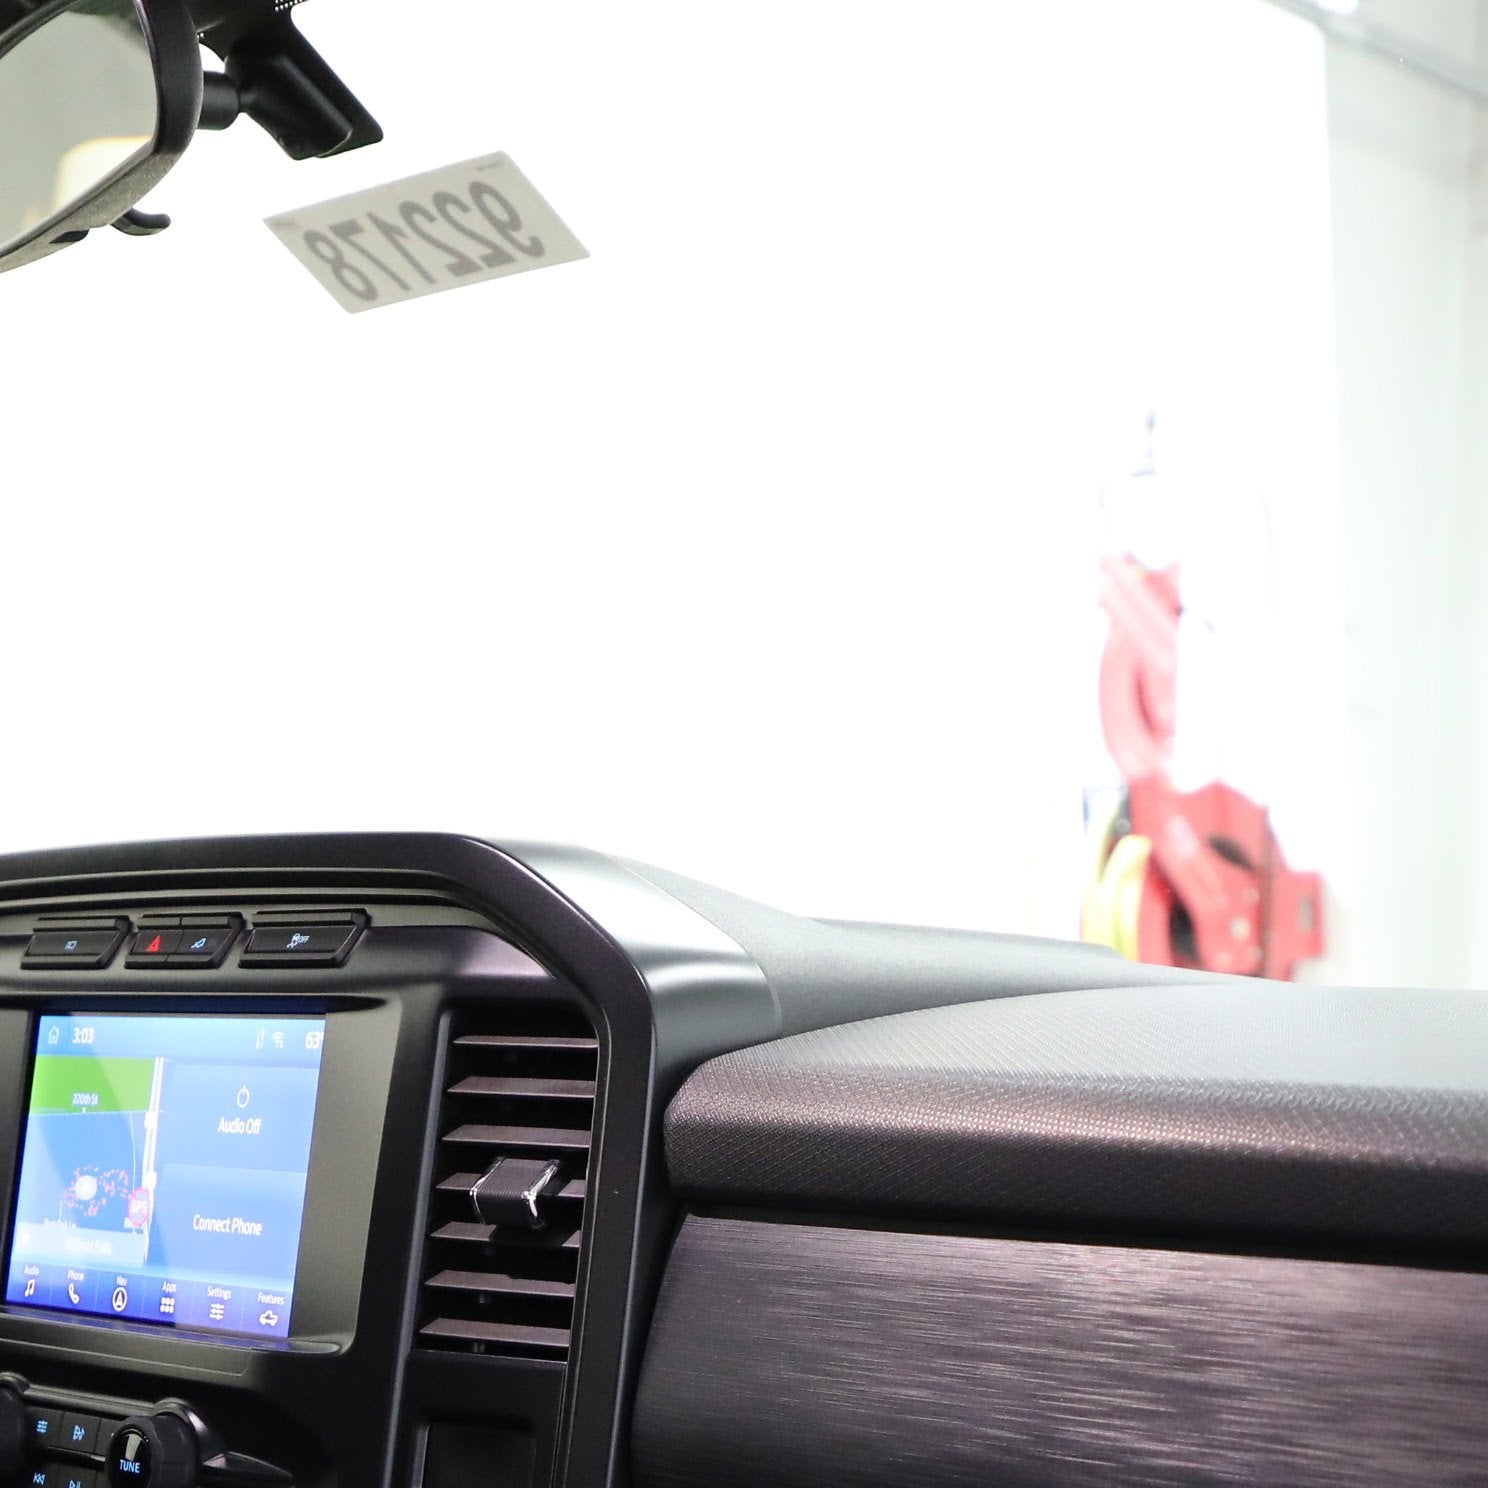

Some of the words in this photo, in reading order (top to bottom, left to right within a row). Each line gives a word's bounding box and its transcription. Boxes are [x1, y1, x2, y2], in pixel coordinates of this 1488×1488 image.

[297, 934, 310, 944] OFF
[71, 1027, 95, 1045] 3:03
[217, 1117, 244, 1134] Audio
[244, 1118, 262, 1136] Off
[192, 1214, 230, 1232] Connect
[231, 1218, 263, 1236] Phone
[23, 1265, 40, 1277] Audio
[67, 1269, 85, 1283] Phone
[116, 1275, 128, 1287] Nav
[161, 1281, 178, 1295] Apps
[206, 1286, 233, 1301] Settings
[257, 1290, 285, 1307] Features
[119, 1458, 141, 1475] TUNE
